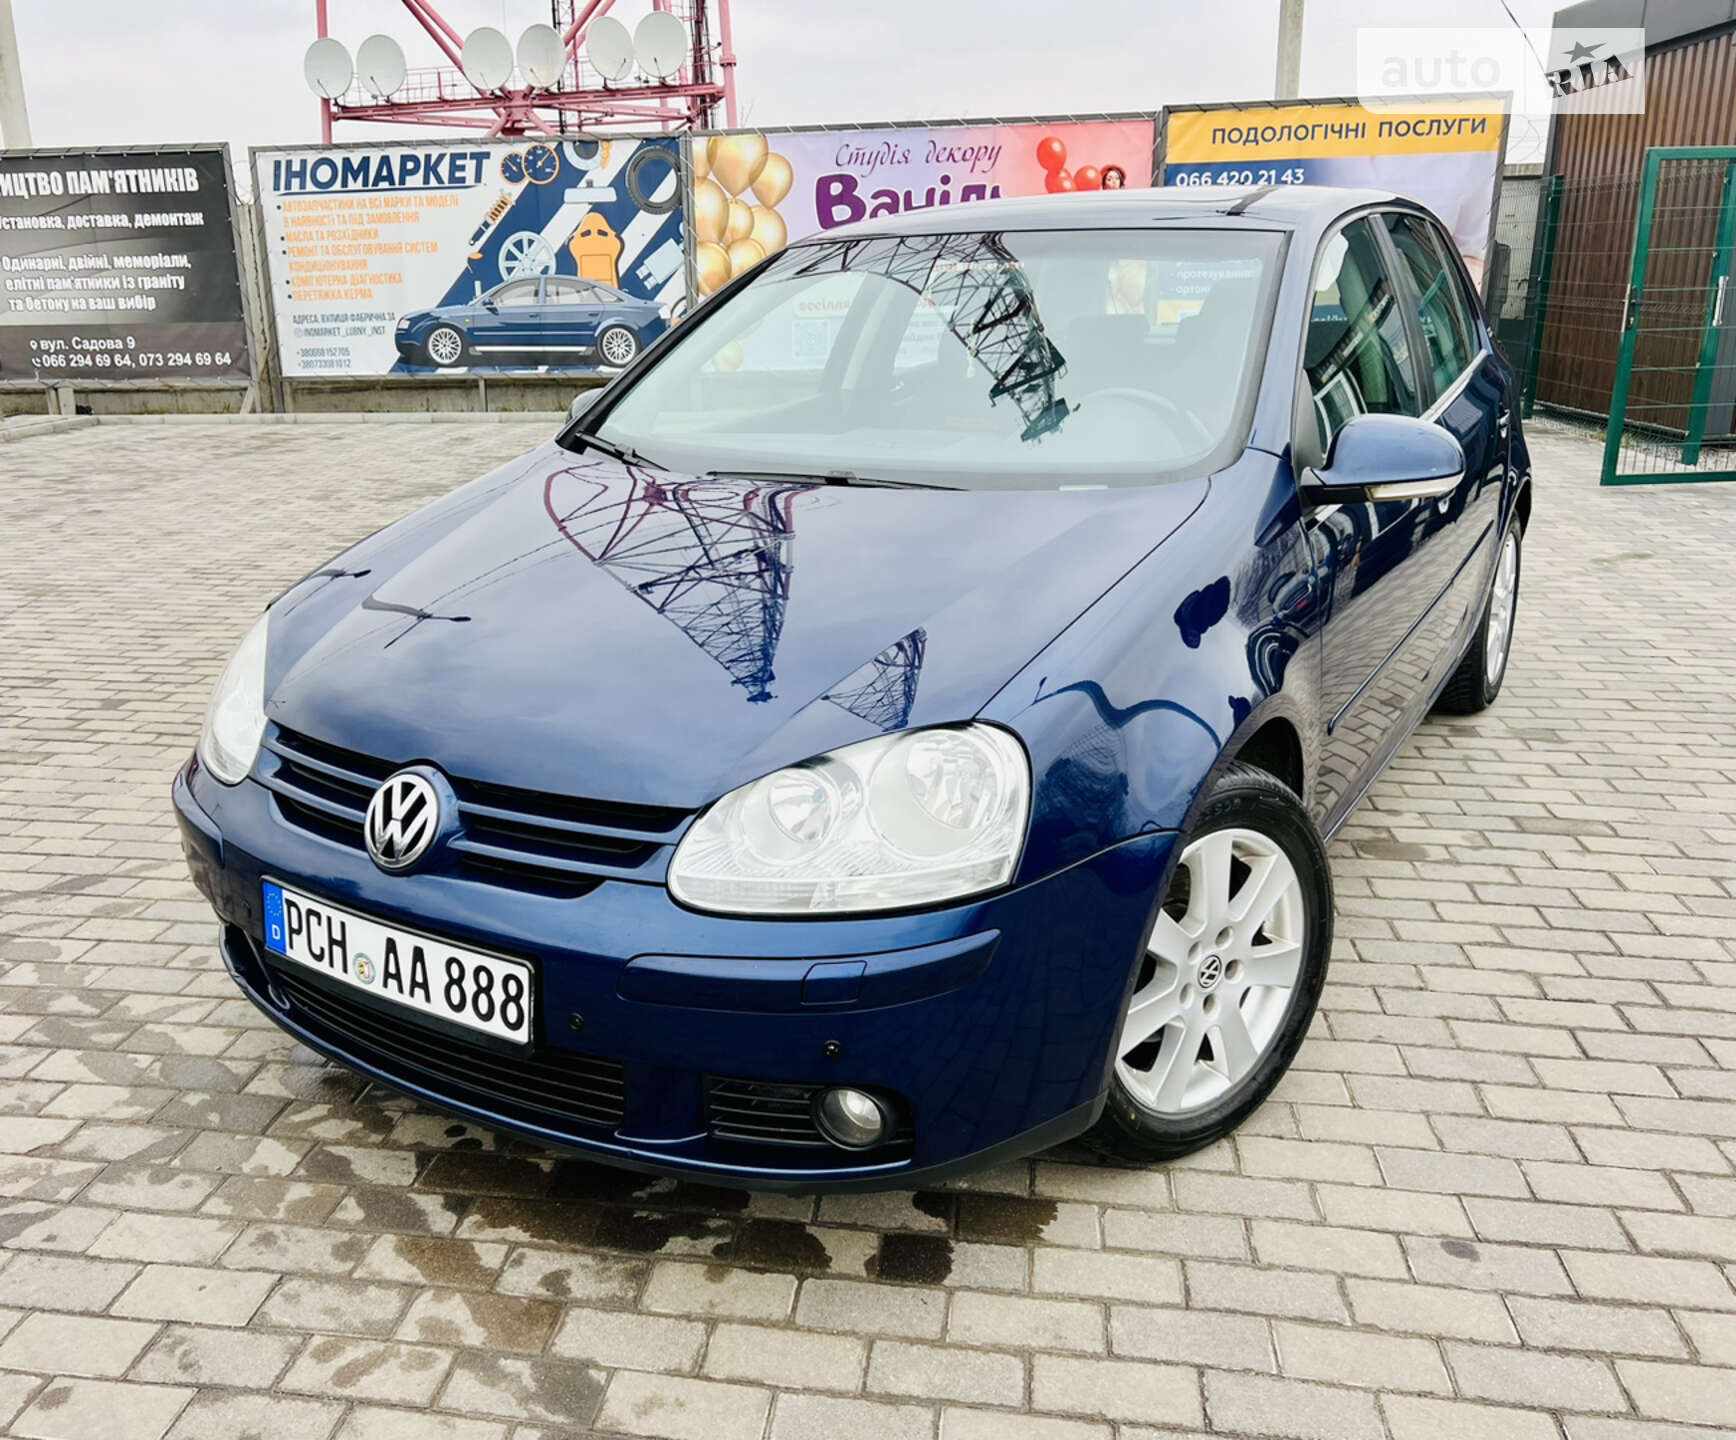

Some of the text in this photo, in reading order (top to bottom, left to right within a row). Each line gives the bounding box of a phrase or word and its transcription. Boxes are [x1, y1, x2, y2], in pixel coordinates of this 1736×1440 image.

[1212, 117, 1487, 146] ПОДОЛОГІЧНІ ПОСЛУГИ
[835, 140, 1002, 178] Студія декору
[272, 151, 491, 192] ІНОМАРКЕТ
[1176, 168, 1304, 186] 066 420 21 43
[66, 167, 199, 195] ПАМ'ЯТНИКІВ
[67, 213, 132, 230] доставка,
[134, 211, 204, 228] демонтаж
[2, 255, 66, 271] Одинарні,
[113, 253, 192, 270] меморіали,
[6, 277, 45, 291] елітні
[123, 275, 135, 288] із
[138, 274, 185, 290] граніту
[8, 295, 156, 312] та бетону на ваш вибір
[40, 336, 135, 351] вул. Садова 9
[42, 351, 232, 369] 066 294 69 64, 073 294 69 64
[272, 924, 281, 940] D
[285, 897, 525, 1032] PCH AA 888
